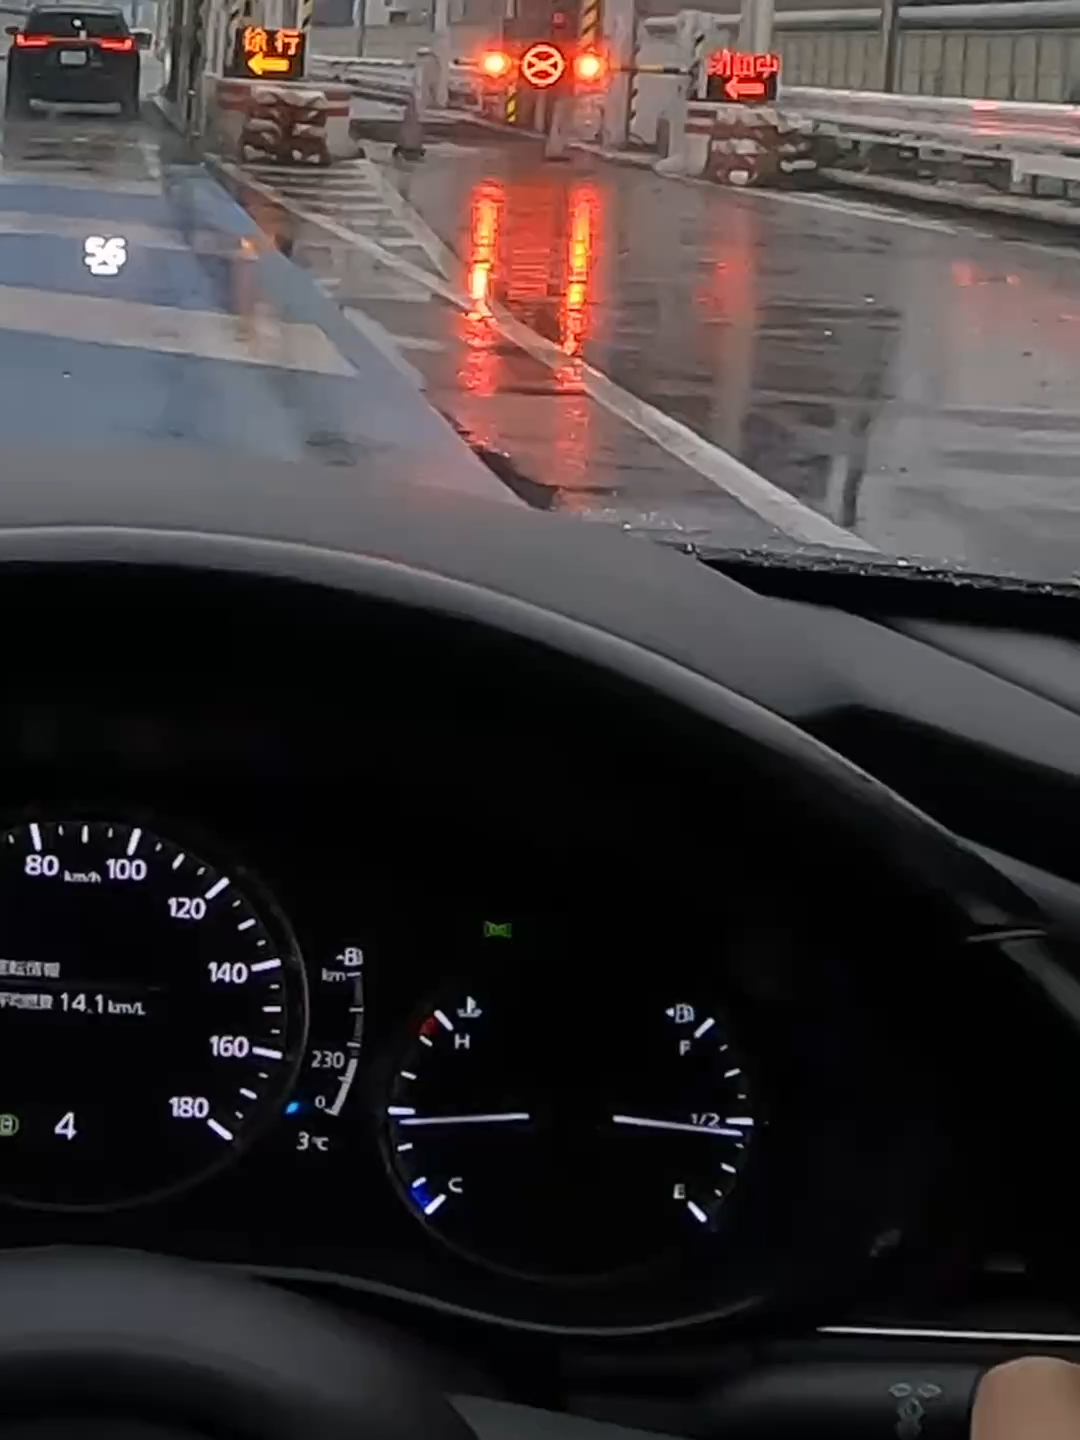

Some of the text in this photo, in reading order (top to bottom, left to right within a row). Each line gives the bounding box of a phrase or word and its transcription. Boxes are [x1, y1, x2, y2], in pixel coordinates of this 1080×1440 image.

[24, 854, 60, 877] 80
[106, 858, 147, 881] 100
[167, 896, 207, 920] 120
[208, 961, 249, 984] 140
[209, 1035, 250, 1058] 160
[454, 1033, 471, 1049] H
[311, 1050, 345, 1069] 230
[168, 1096, 209, 1119] 180
[314, 1095, 326, 1109] 0
[54, 1111, 78, 1140] 4
[690, 1113, 720, 1128] 1/2
[447, 1177, 463, 1193] C
[673, 1184, 685, 1200] E
